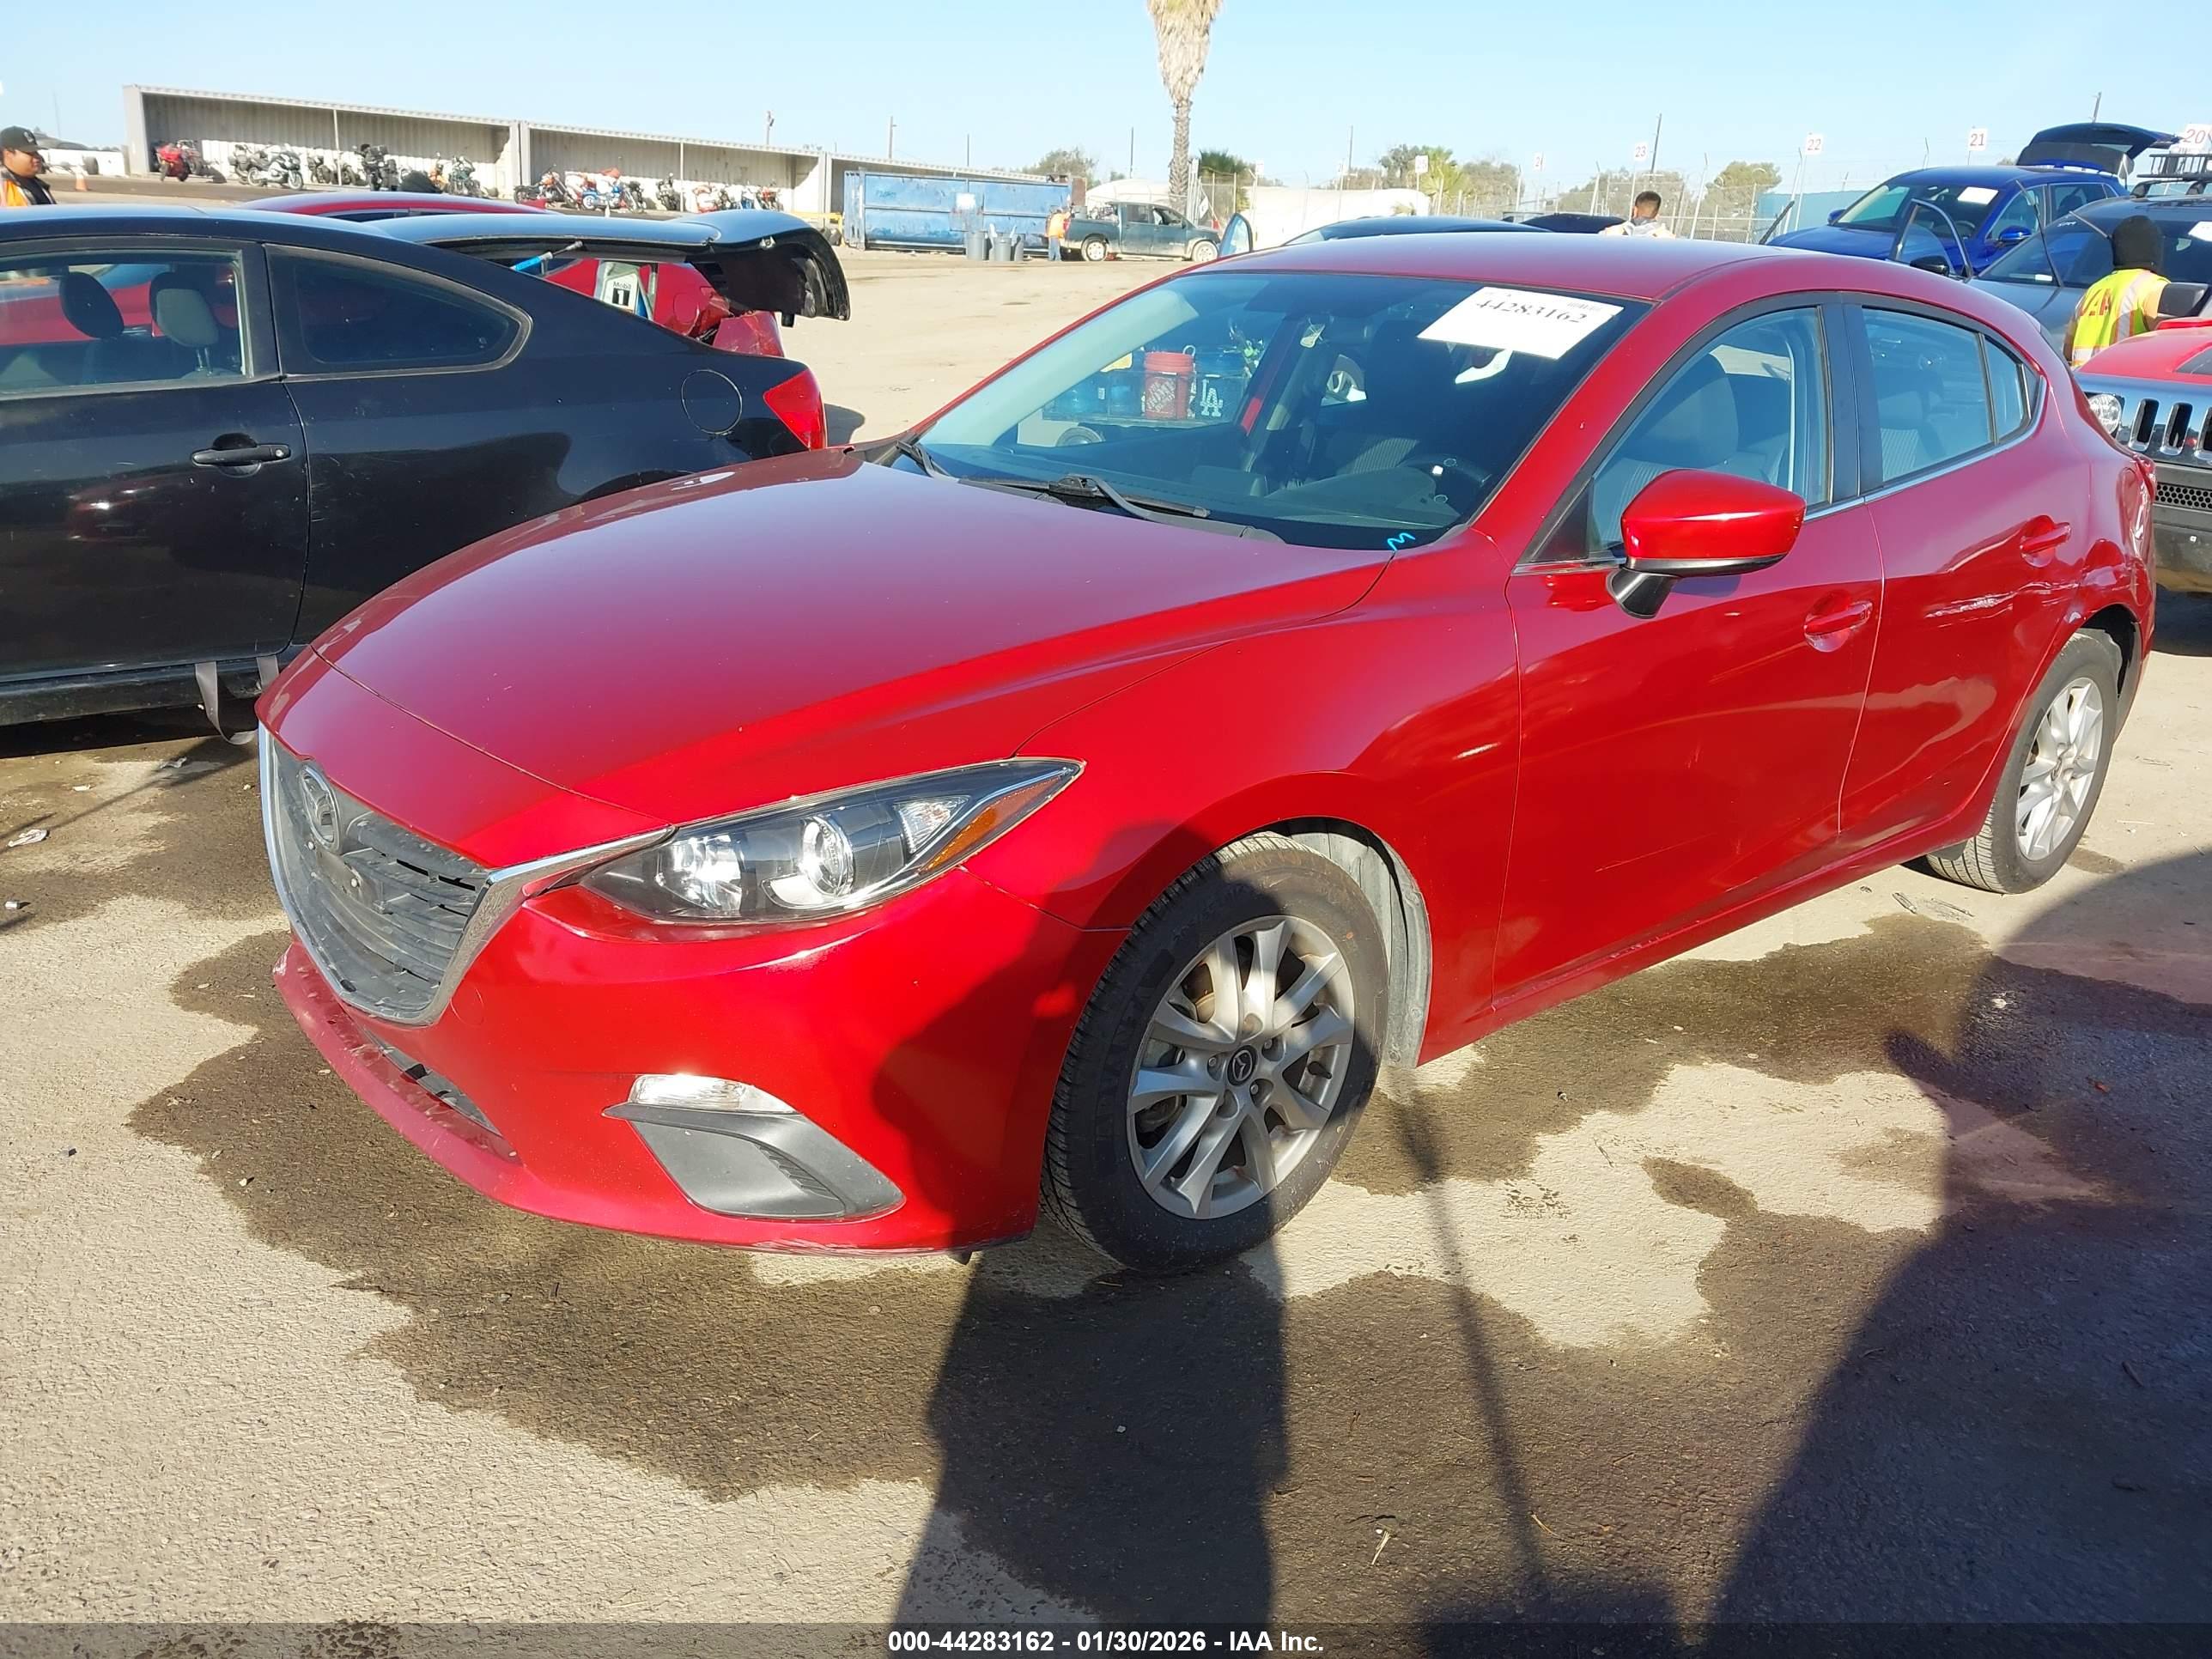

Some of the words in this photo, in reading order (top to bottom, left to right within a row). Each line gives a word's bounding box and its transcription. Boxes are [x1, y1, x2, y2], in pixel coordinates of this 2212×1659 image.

[1969, 132, 1984, 146] 21
[2183, 129, 2206, 144] 20
[1807, 138, 1821, 150] 22
[1476, 299, 1588, 324] 44283162
